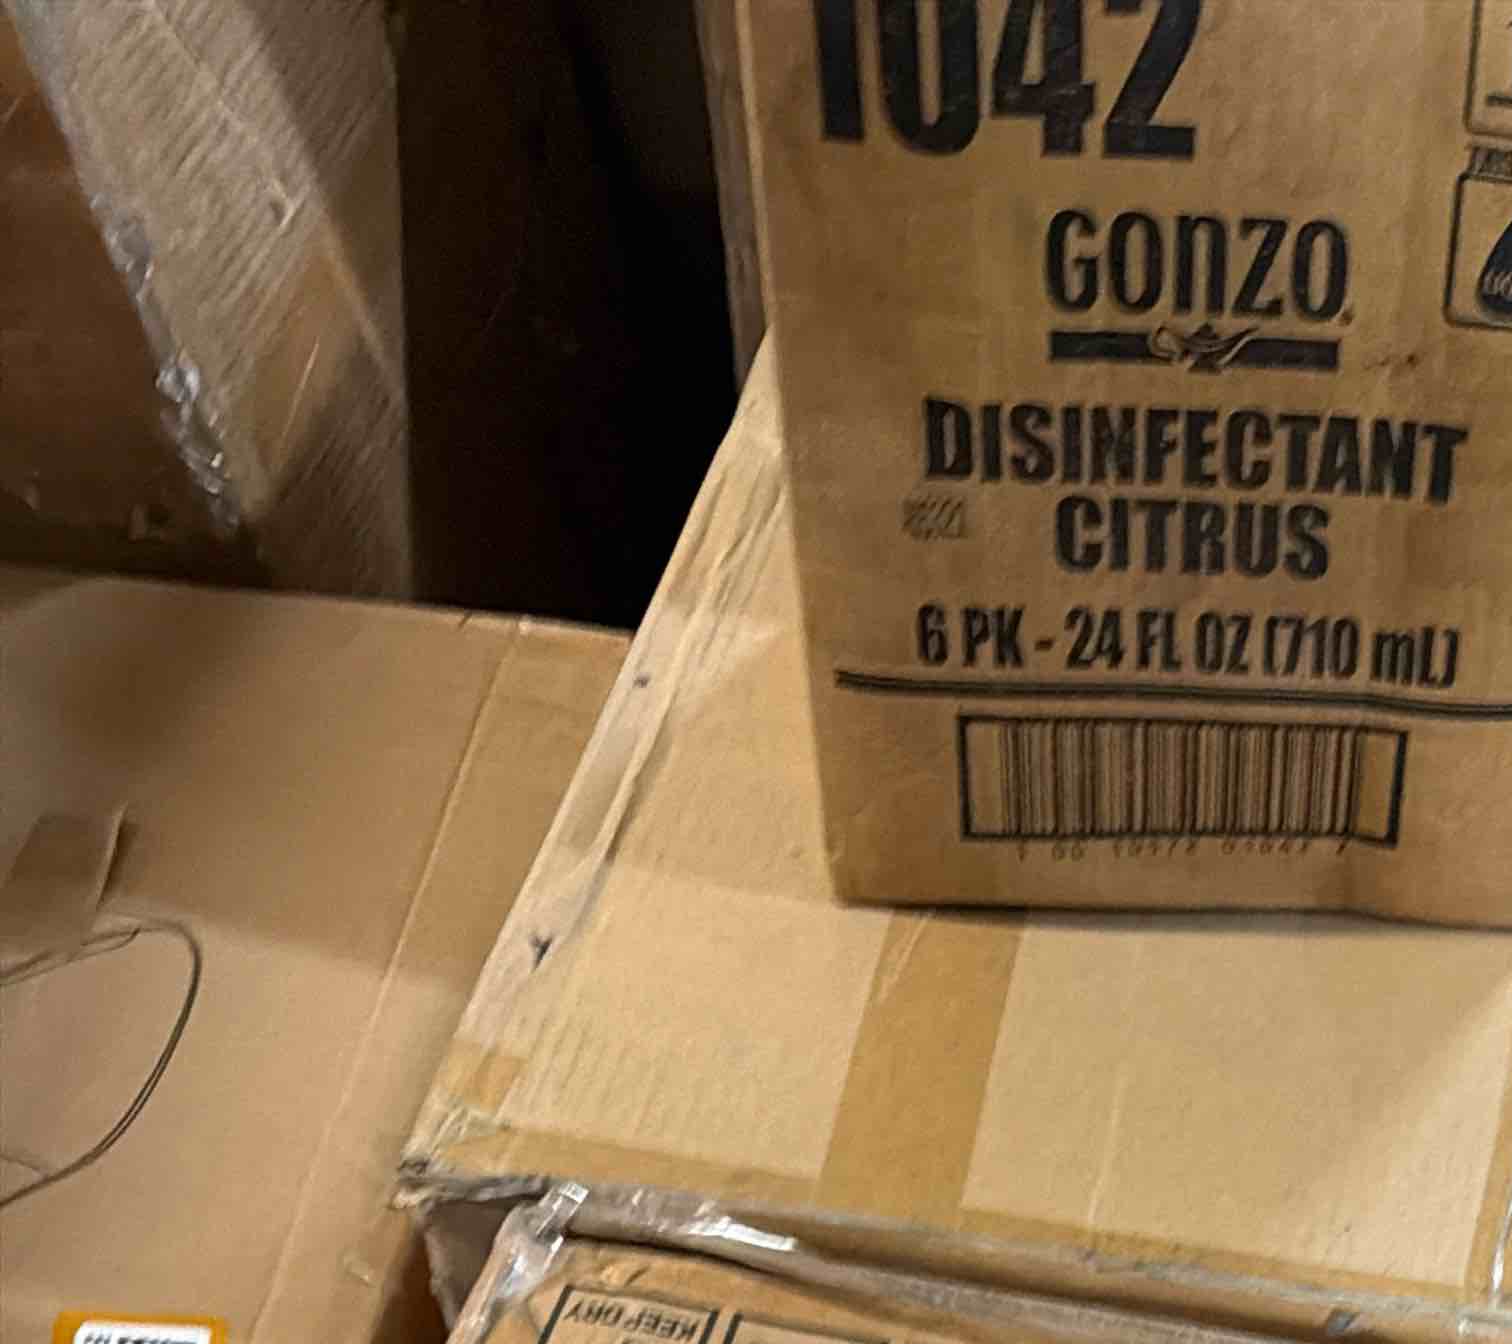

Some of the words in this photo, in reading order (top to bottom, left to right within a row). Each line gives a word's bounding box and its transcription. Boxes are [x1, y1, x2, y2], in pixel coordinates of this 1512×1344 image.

[922, 396, 1470, 504] DISINFECTANT
[1053, 495, 1332, 581] CITRUS
[914, 603, 949, 666] 6
[960, 604, 1026, 668] PK
[1064, 606, 1127, 671] 24
[1136, 609, 1186, 672] FL
[1194, 612, 1255, 676] OZ
[563, 1299, 626, 1327] DRY
[623, 1308, 701, 1343] KEEP
